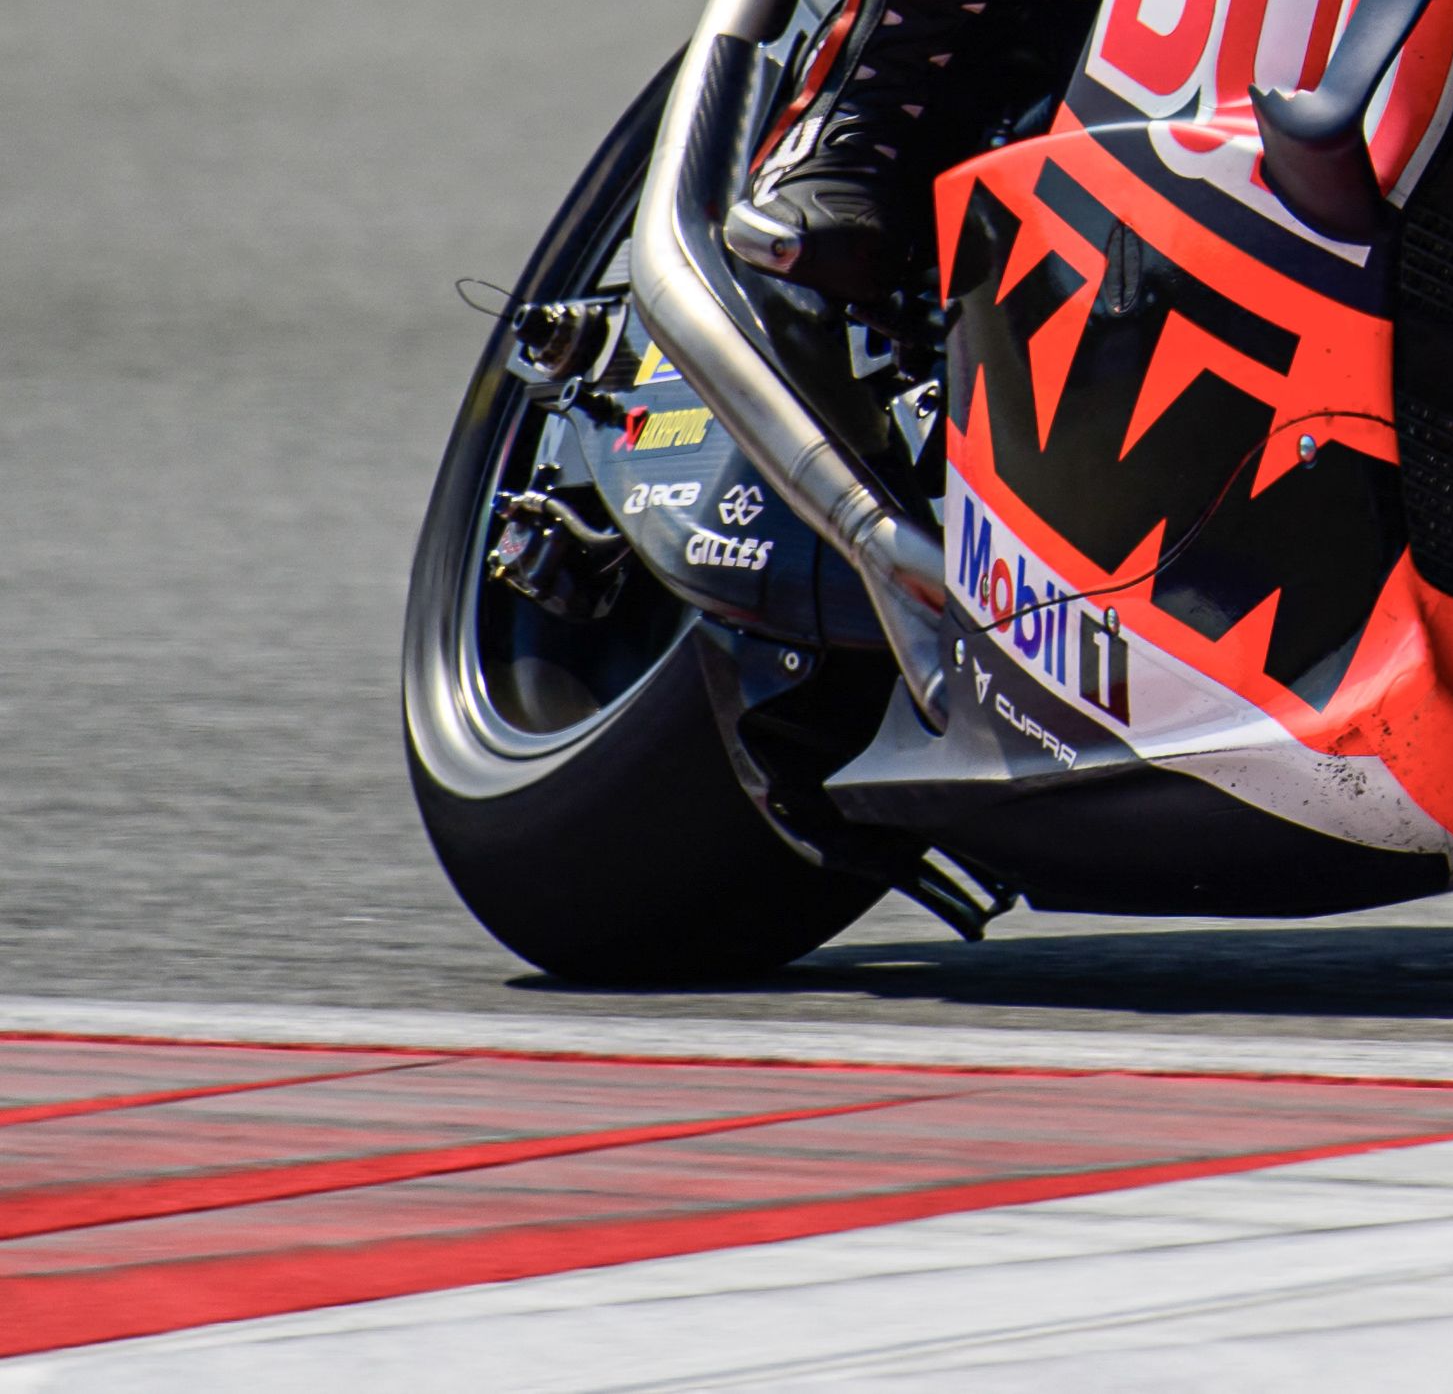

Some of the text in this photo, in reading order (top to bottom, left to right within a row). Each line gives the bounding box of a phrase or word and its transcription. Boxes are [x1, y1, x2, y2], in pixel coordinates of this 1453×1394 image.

[946, 156, 1399, 714] KTM
[650, 482, 701, 507] RCB
[686, 534, 774, 570] GILLES
[959, 495, 1067, 686] Mobil
[996, 693, 1077, 769] CUPRA
